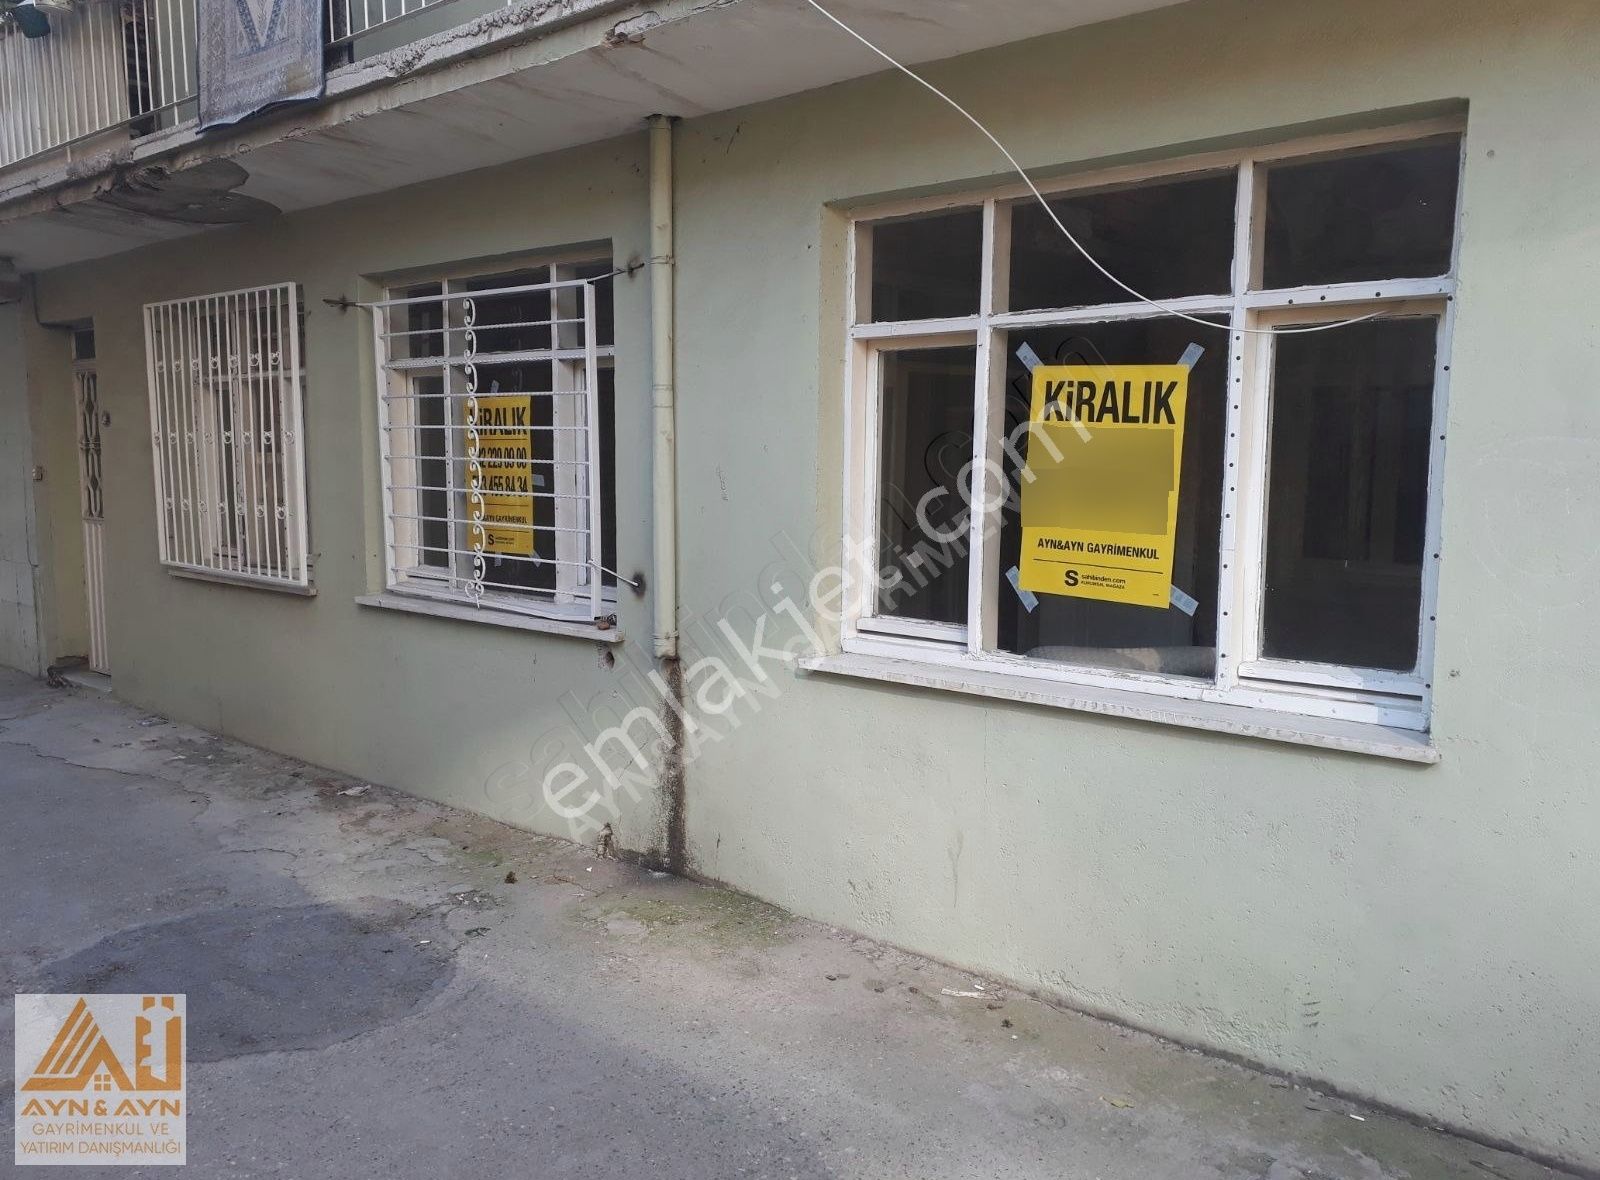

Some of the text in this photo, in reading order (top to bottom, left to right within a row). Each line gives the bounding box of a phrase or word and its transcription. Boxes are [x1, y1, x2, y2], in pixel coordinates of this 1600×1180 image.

[1038, 538, 1159, 560] AYN&AYN GAYRİMENKUL
[1064, 569, 1126, 587] S sahibinden.com
